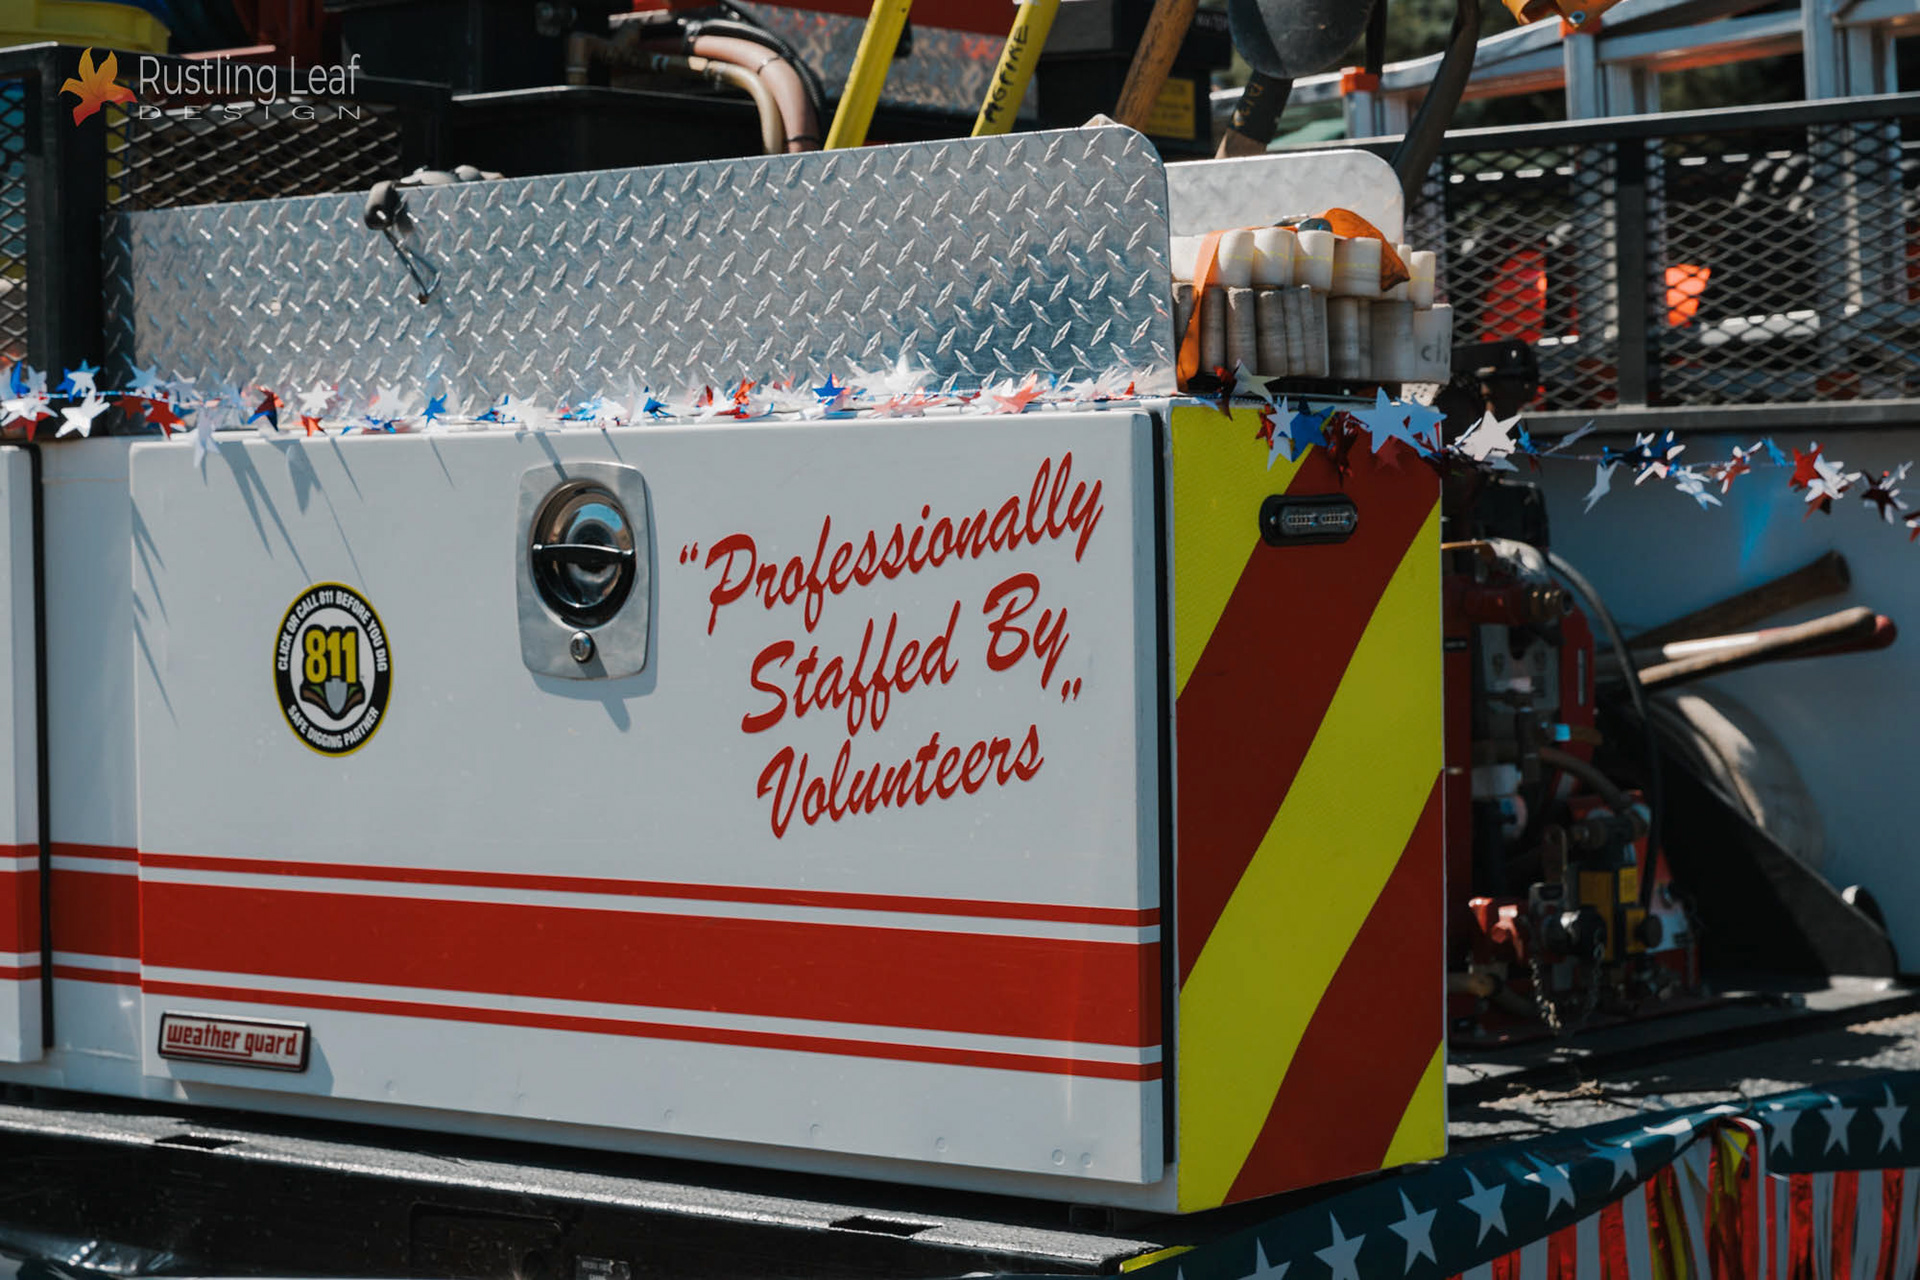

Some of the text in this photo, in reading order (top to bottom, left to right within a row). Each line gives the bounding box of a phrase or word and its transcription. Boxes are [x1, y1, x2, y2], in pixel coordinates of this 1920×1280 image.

[679, 451, 1104, 635] “Professionally
[278, 590, 388, 672] CLICK OR CALL 811 BEFORE YOU DIG
[304, 628, 357, 684] 811
[741, 572, 1070, 736] Staffed By
[287, 704, 380, 748] SAFE DIGGING PARTNER
[167, 1024, 298, 1057] weather guard
